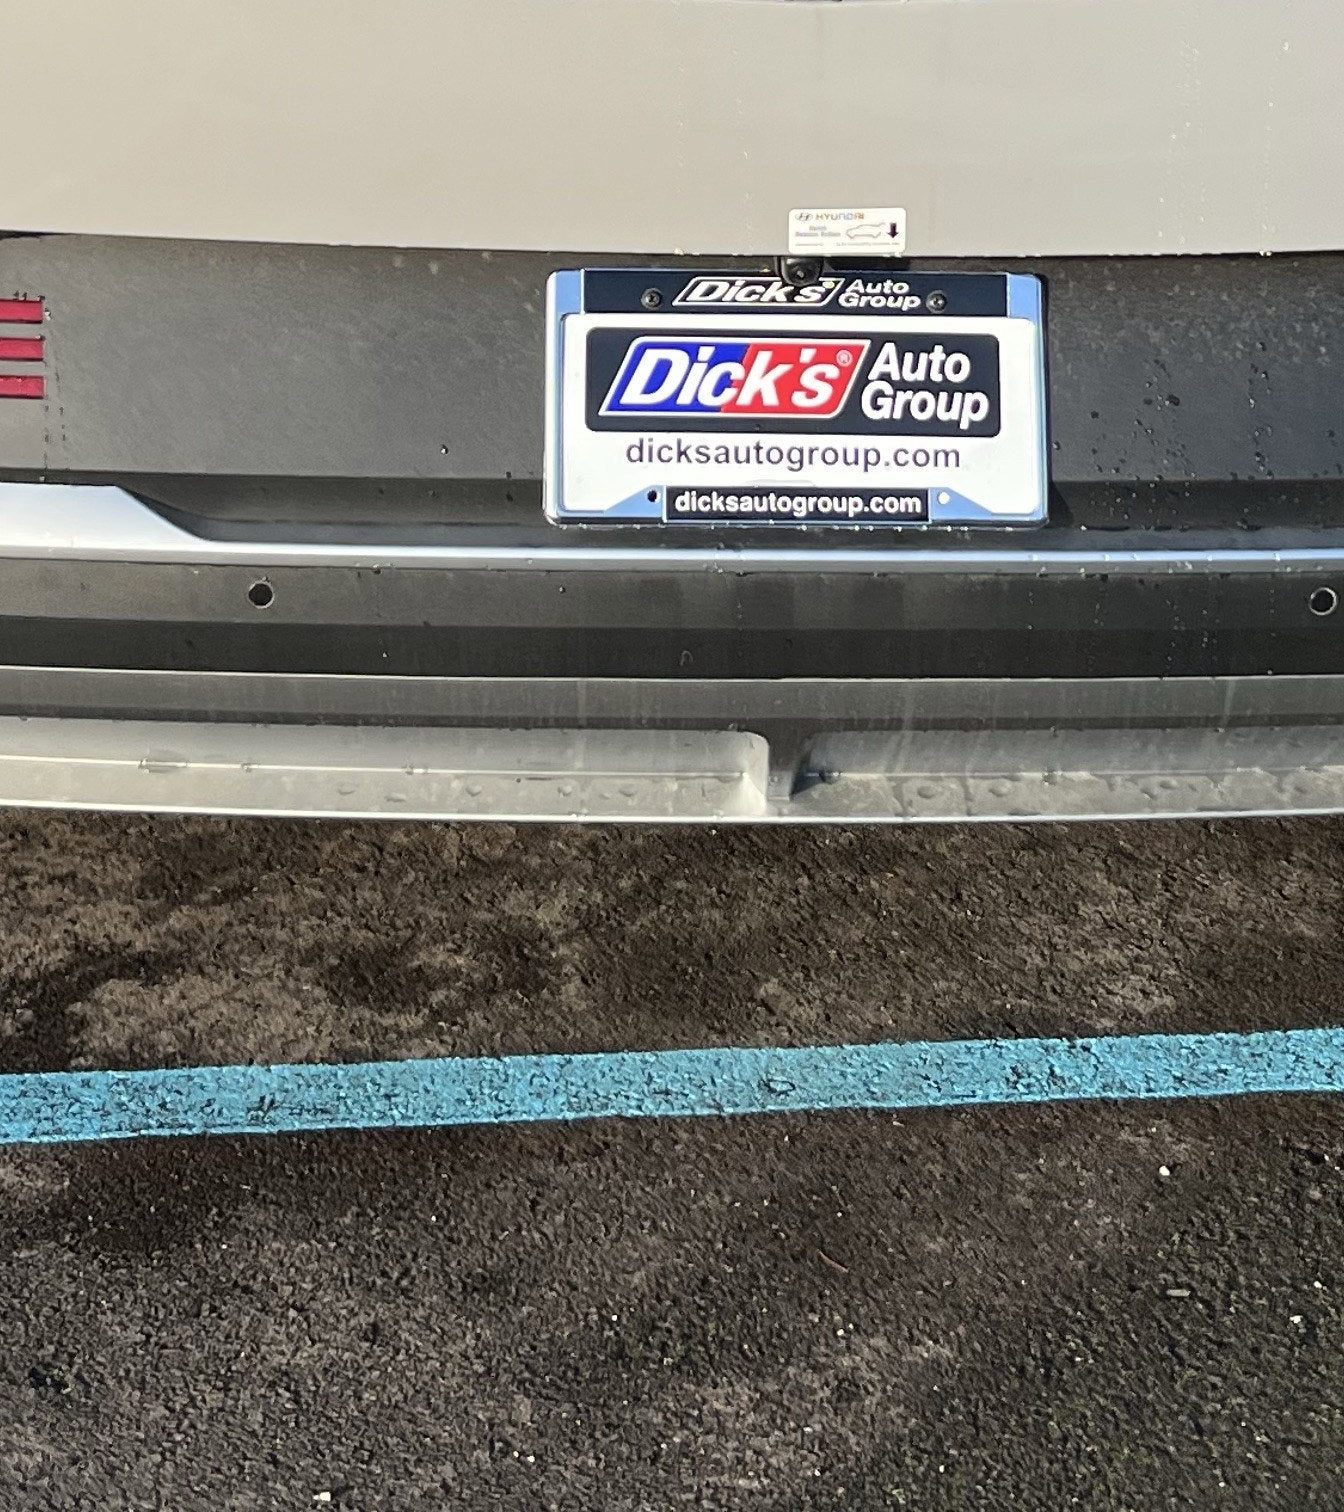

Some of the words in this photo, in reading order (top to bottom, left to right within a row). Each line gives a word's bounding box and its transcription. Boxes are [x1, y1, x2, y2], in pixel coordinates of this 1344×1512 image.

[686, 280, 828, 303] Dicks
[837, 291, 922, 312] Group
[844, 278, 911, 295] Auto
[619, 344, 840, 409] Dick's
[867, 341, 972, 384] Auto
[860, 380, 991, 430] Group
[625, 437, 961, 473] dicksautogroup.com
[673, 490, 923, 518] dicksautogroup.com
